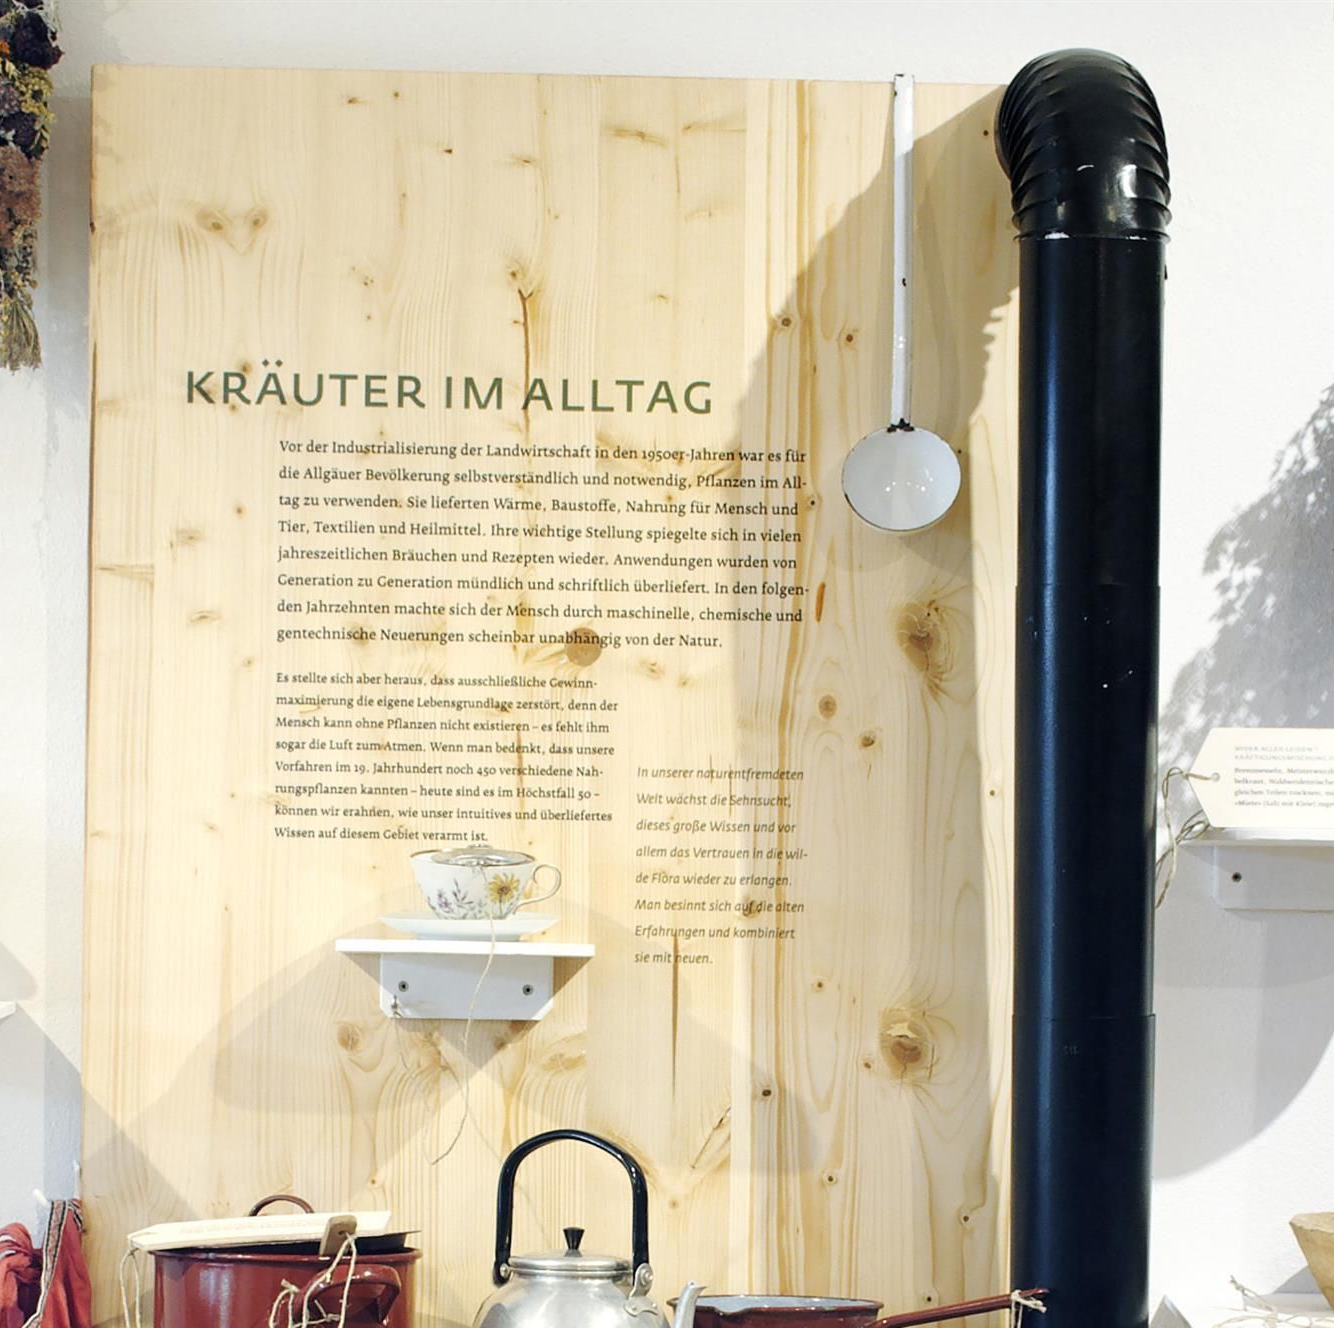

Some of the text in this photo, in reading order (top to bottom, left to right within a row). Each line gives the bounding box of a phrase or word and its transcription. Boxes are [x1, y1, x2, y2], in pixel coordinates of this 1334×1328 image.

[187, 359, 711, 414] KRÄUTER IM ALLTAG
[279, 438, 805, 462] Vor der Industrialisierung der Landwirtschaft in den 1950er-Jahren war es für
[278, 464, 806, 491] die Allgäuer Bevölkerung selbstverständlich und notwendig, Pflanzen im All-
[278, 493, 798, 517] tag zu verwenden. Sie lieferten Wärme, Baustoffe, Nahrung für Mensch und
[277, 519, 801, 544] Tier, Textilien und Heilmittel. Ihre wichtige Stellung spiegelte sich in vielen
[277, 545, 797, 571] jahreszeitlichen Bräuchen und Rezepten wieder. Anwendungen wurden von
[277, 573, 809, 598] Generation zu Generation mündlich und schriftlich überliefert. In den folgen-
[275, 671, 597, 688] Es stellte sich aber heraus, dass ausschließliche Gewinn-
[275, 694, 618, 713] maximierung die eigene Lebensgrundlage zerstört, denn der
[275, 759, 603, 777] Vorfahren im 19. Jahrhundert noch 450 verschiedene Nah-
[274, 826, 488, 841] Wissen auf diesem Gebiet verarmt ist.
[635, 818, 795, 834] dieses große Wissen und vor
[635, 845, 667, 857] allem
[669, 845, 690, 858] das
[692, 847, 750, 859] Vertrauen
[753, 847, 762, 859] in
[766, 848, 783, 859] die
